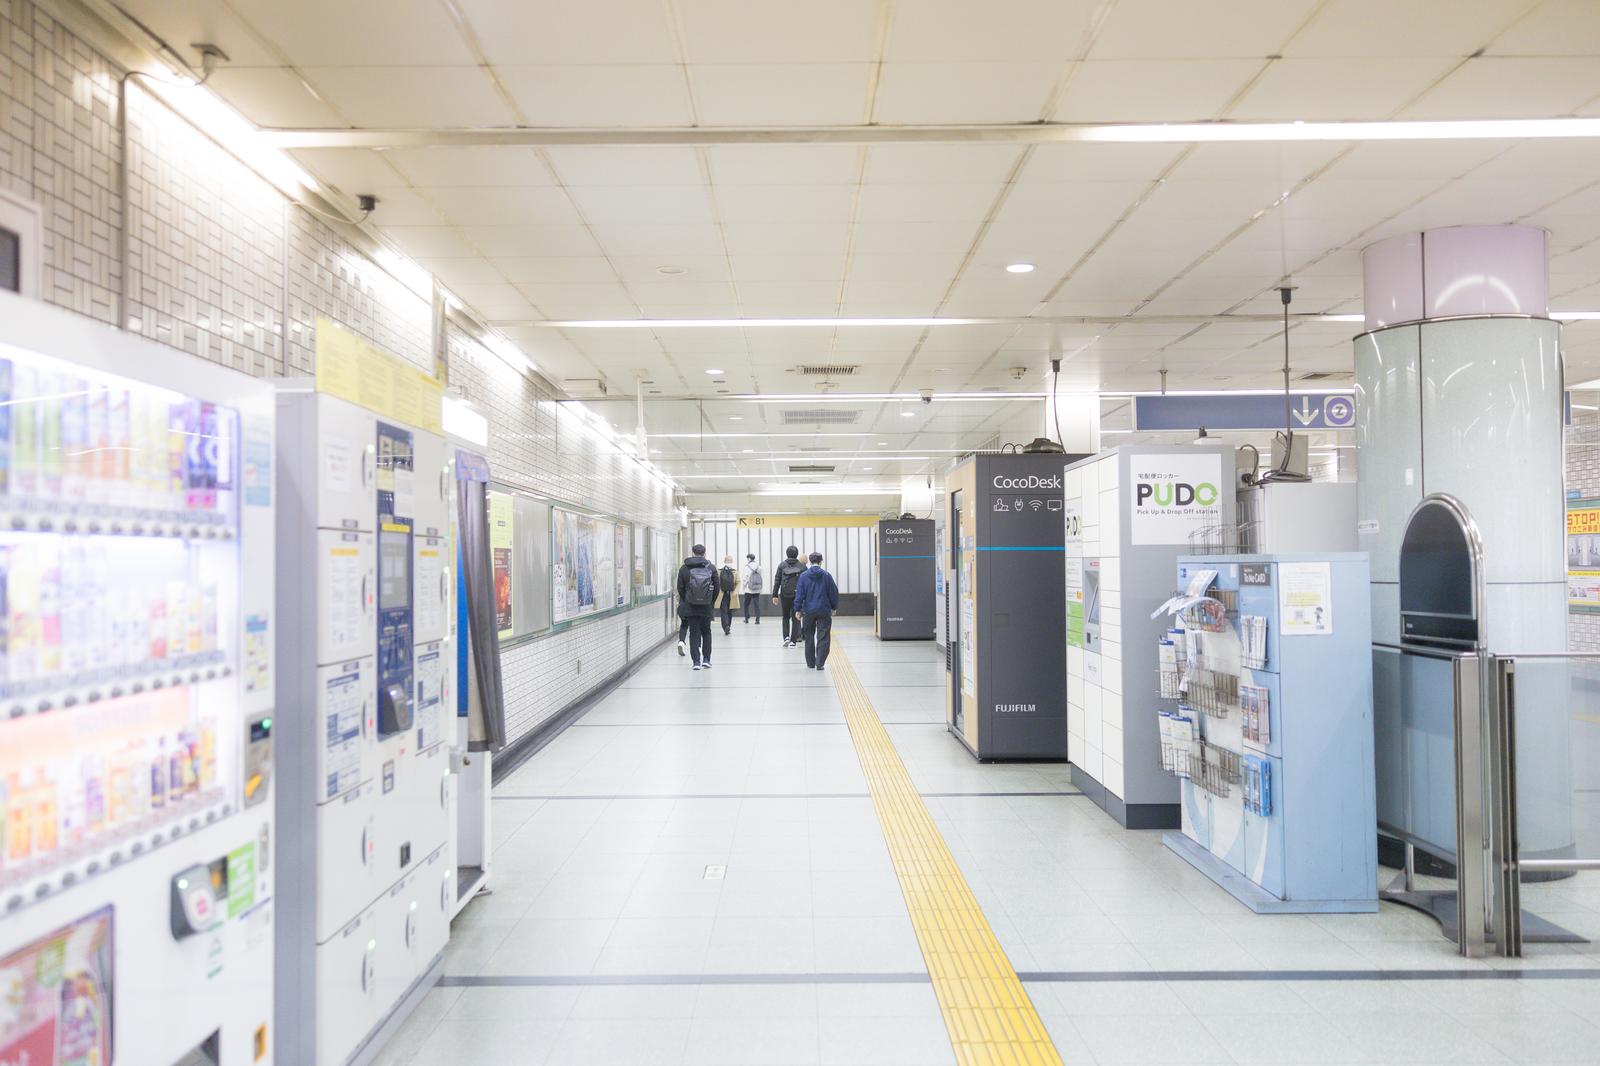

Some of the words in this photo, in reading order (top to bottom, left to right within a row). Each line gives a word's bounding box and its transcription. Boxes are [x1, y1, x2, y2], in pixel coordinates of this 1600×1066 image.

[1336, 406, 1344, 416] Z
[993, 474, 1062, 489] CocoDesk
[1137, 482, 1218, 506] PUDO
[995, 704, 1036, 712] FUJIFILM
